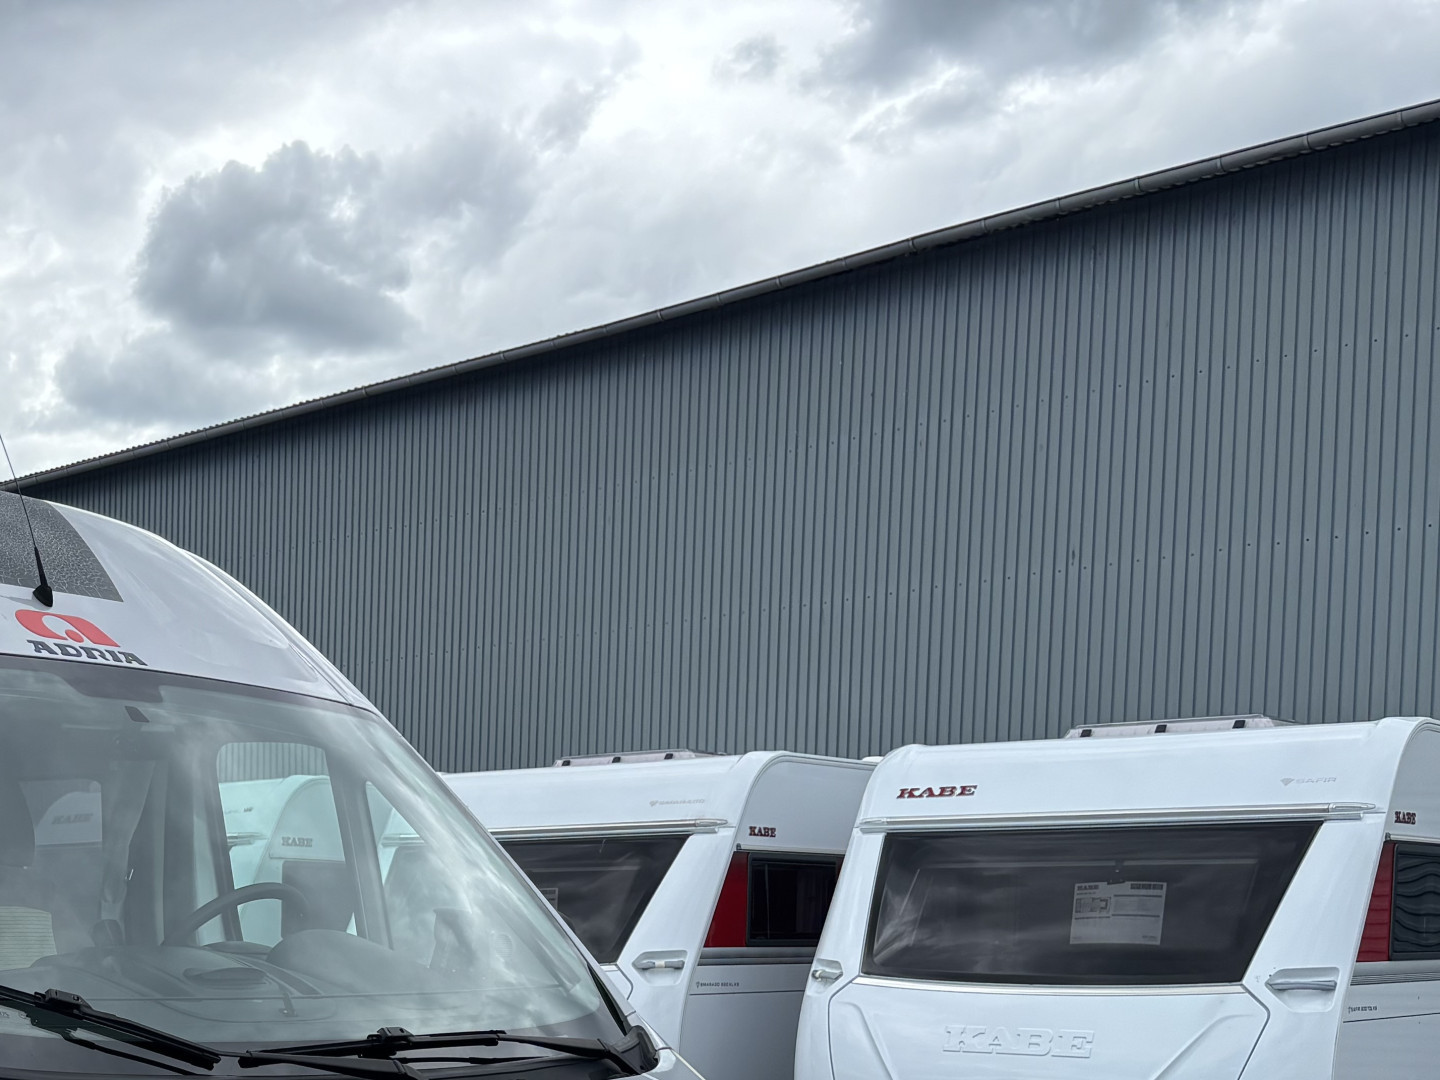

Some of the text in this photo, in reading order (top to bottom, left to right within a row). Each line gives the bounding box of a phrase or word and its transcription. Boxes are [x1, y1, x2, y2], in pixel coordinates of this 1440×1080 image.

[27, 639, 148, 666] ADRIA
[896, 784, 978, 799] KABE
[1394, 811, 1417, 825] KABE
[748, 826, 777, 838] KABE
[281, 836, 313, 848] KABE
[942, 1024, 1095, 1059] KABE
